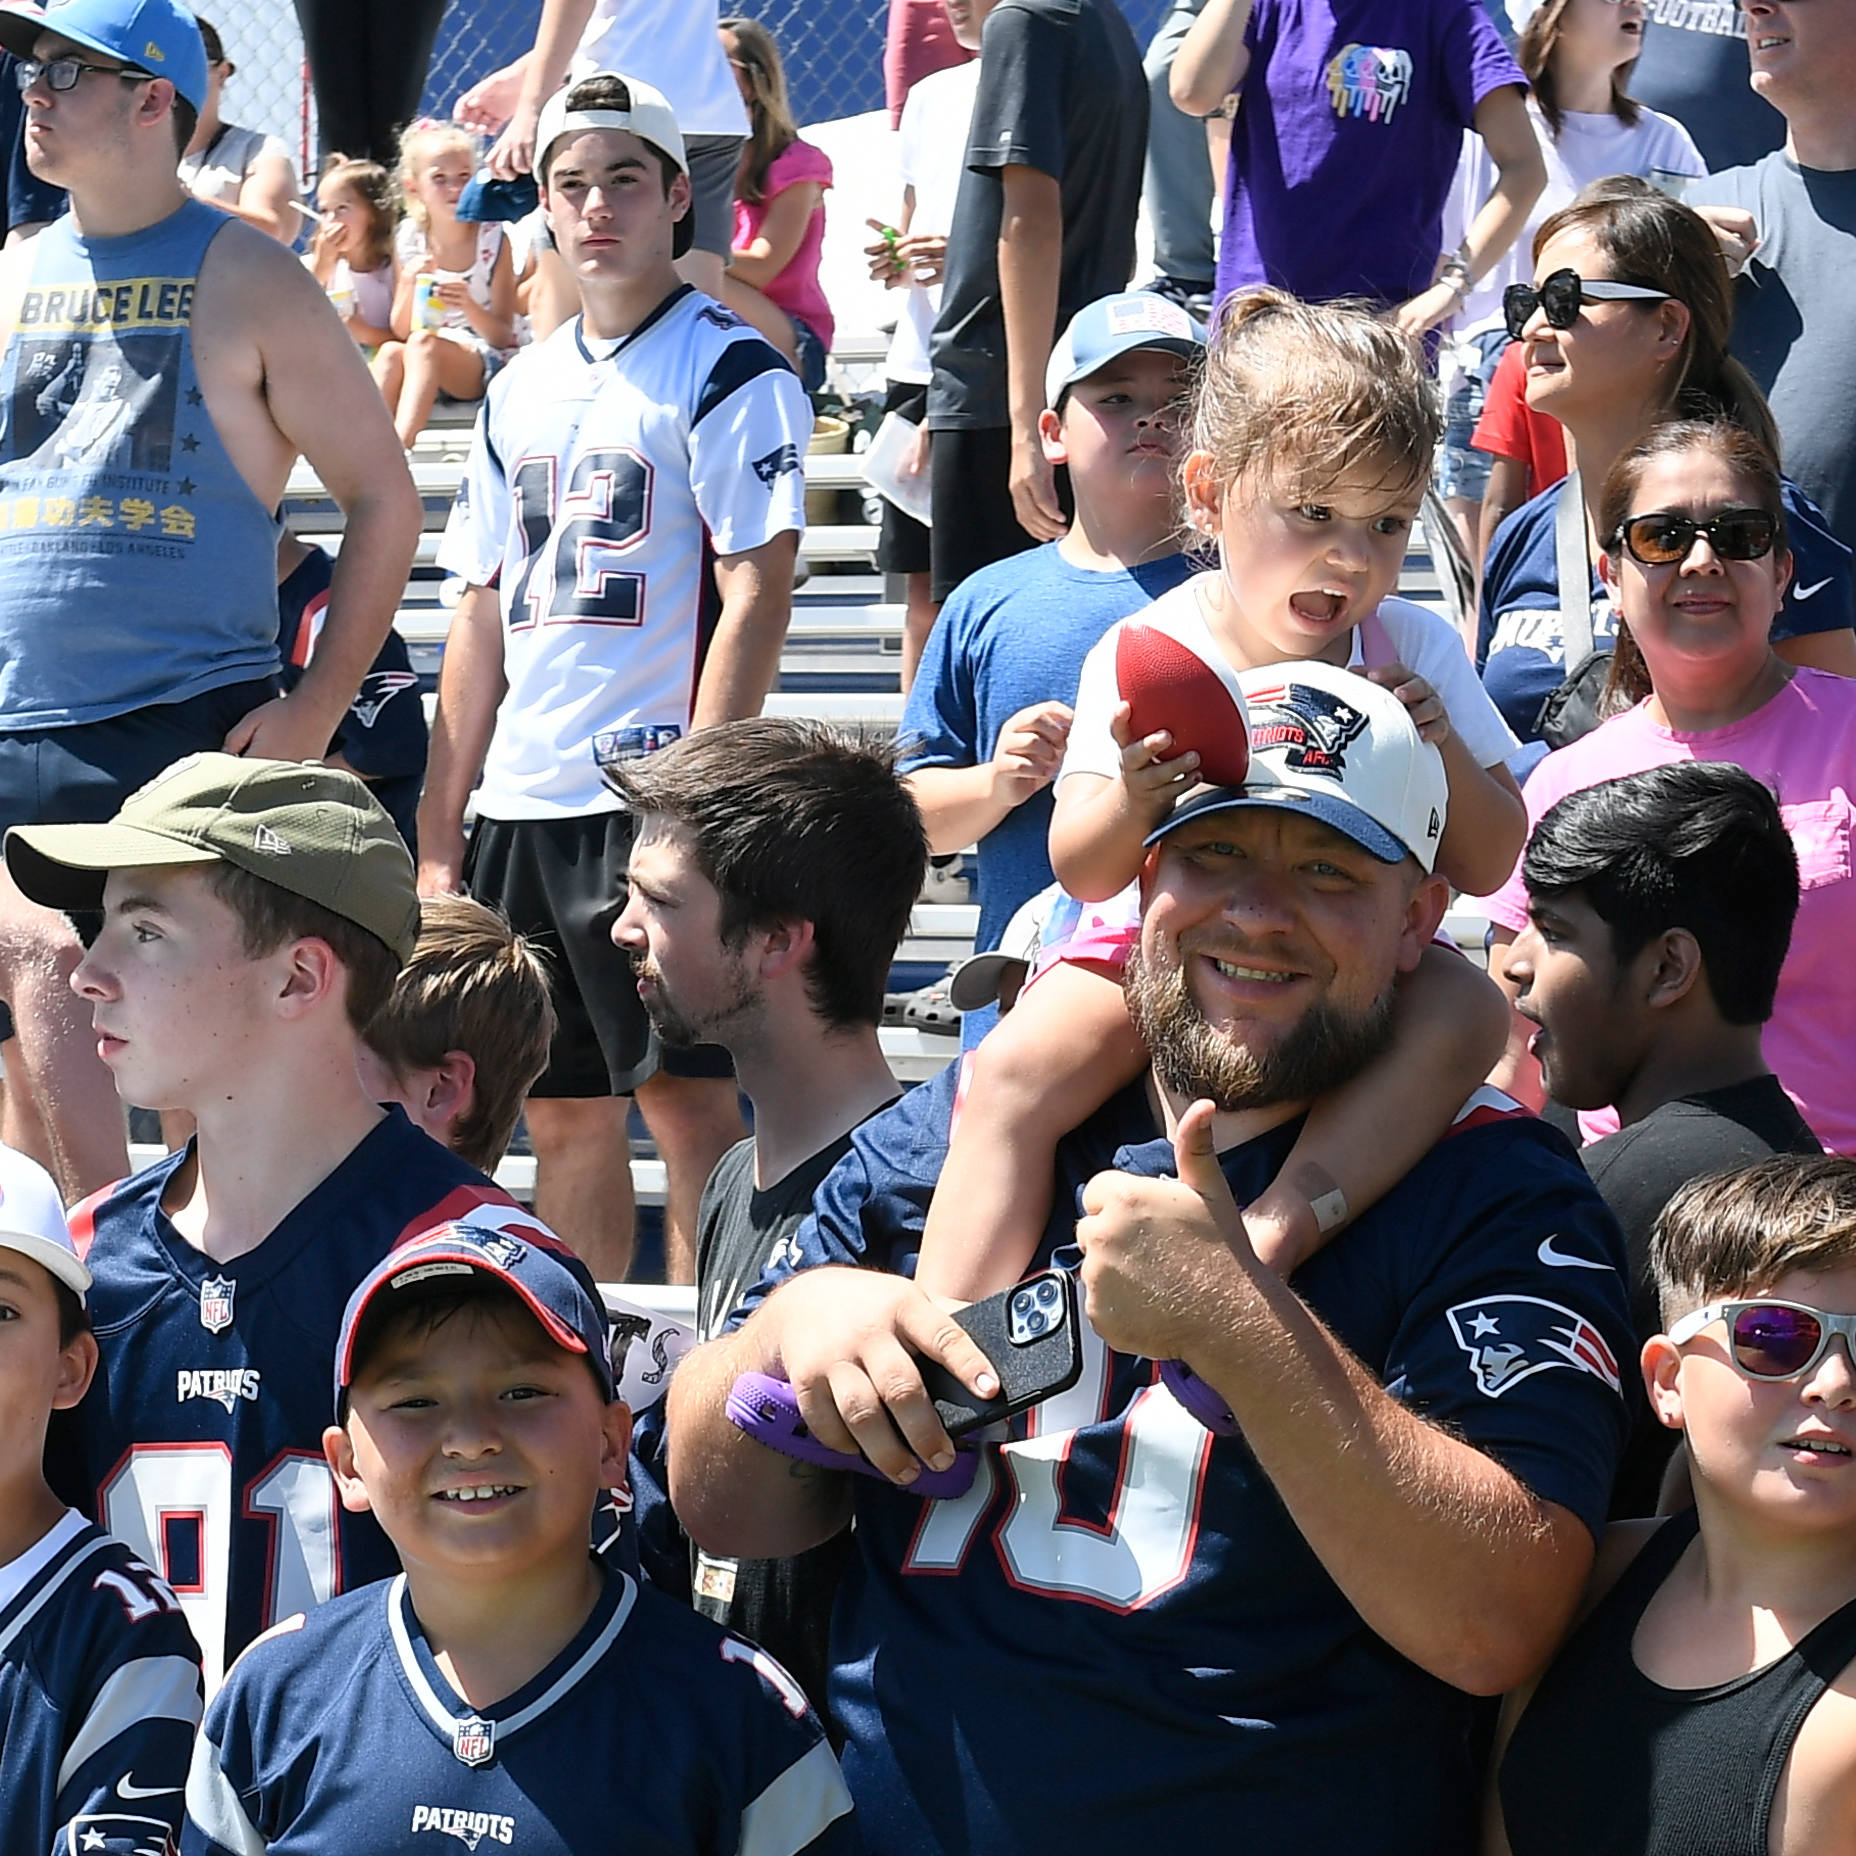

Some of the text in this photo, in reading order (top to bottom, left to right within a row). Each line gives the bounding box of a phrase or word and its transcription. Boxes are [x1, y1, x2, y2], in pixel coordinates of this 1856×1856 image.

[1647, 0, 1748, 40] OOTBAL
[21, 284, 134, 325] BRUCE
[508, 447, 655, 632] 12
[204, 1299, 233, 1321] NFL
[177, 1368, 262, 1402] PATRIOTS
[459, 1735, 490, 1759] NFL
[410, 1804, 516, 1848] PATRIOTS
